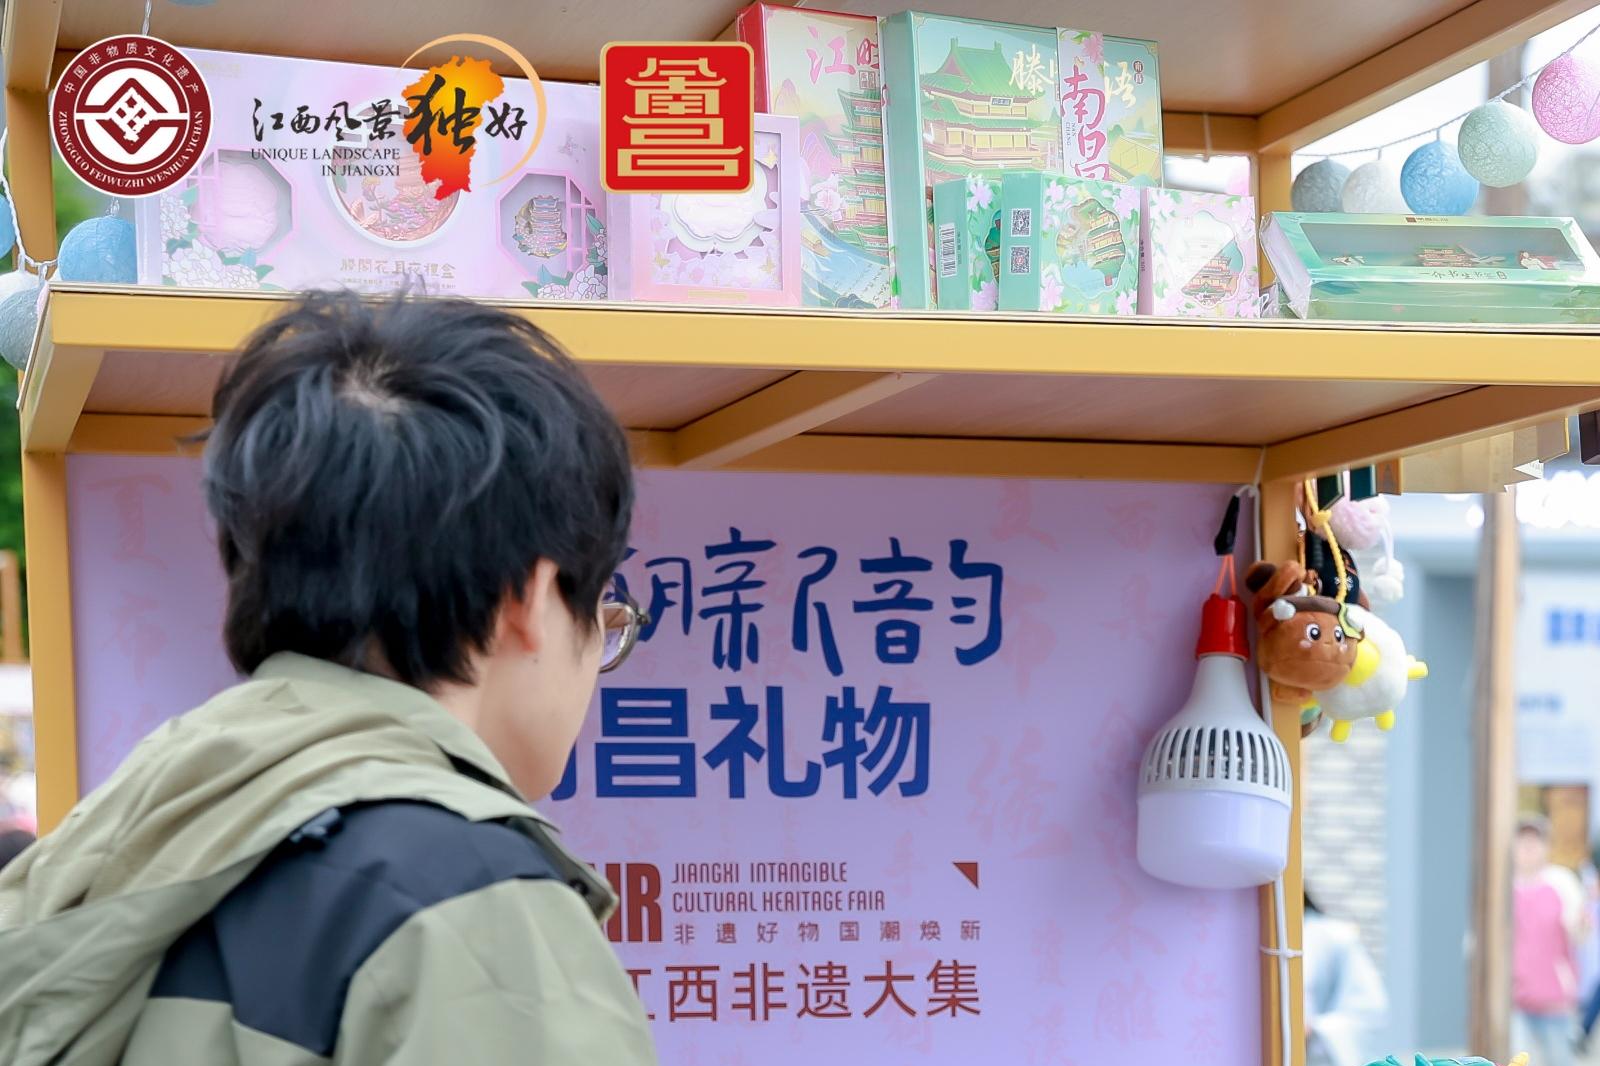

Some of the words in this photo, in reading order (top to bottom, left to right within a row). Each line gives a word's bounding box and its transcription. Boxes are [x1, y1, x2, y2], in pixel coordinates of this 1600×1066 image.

[551, 685, 931, 800] 昌礼物
[671, 863, 740, 884] JIANGXI
[750, 862, 848, 883] INTANGIBLE
[672, 891, 758, 913] CULTURAL
[763, 891, 844, 912] HERITAGE
[848, 890, 886, 912] FAIR
[674, 920, 982, 945] 非遗好物国潮焕新
